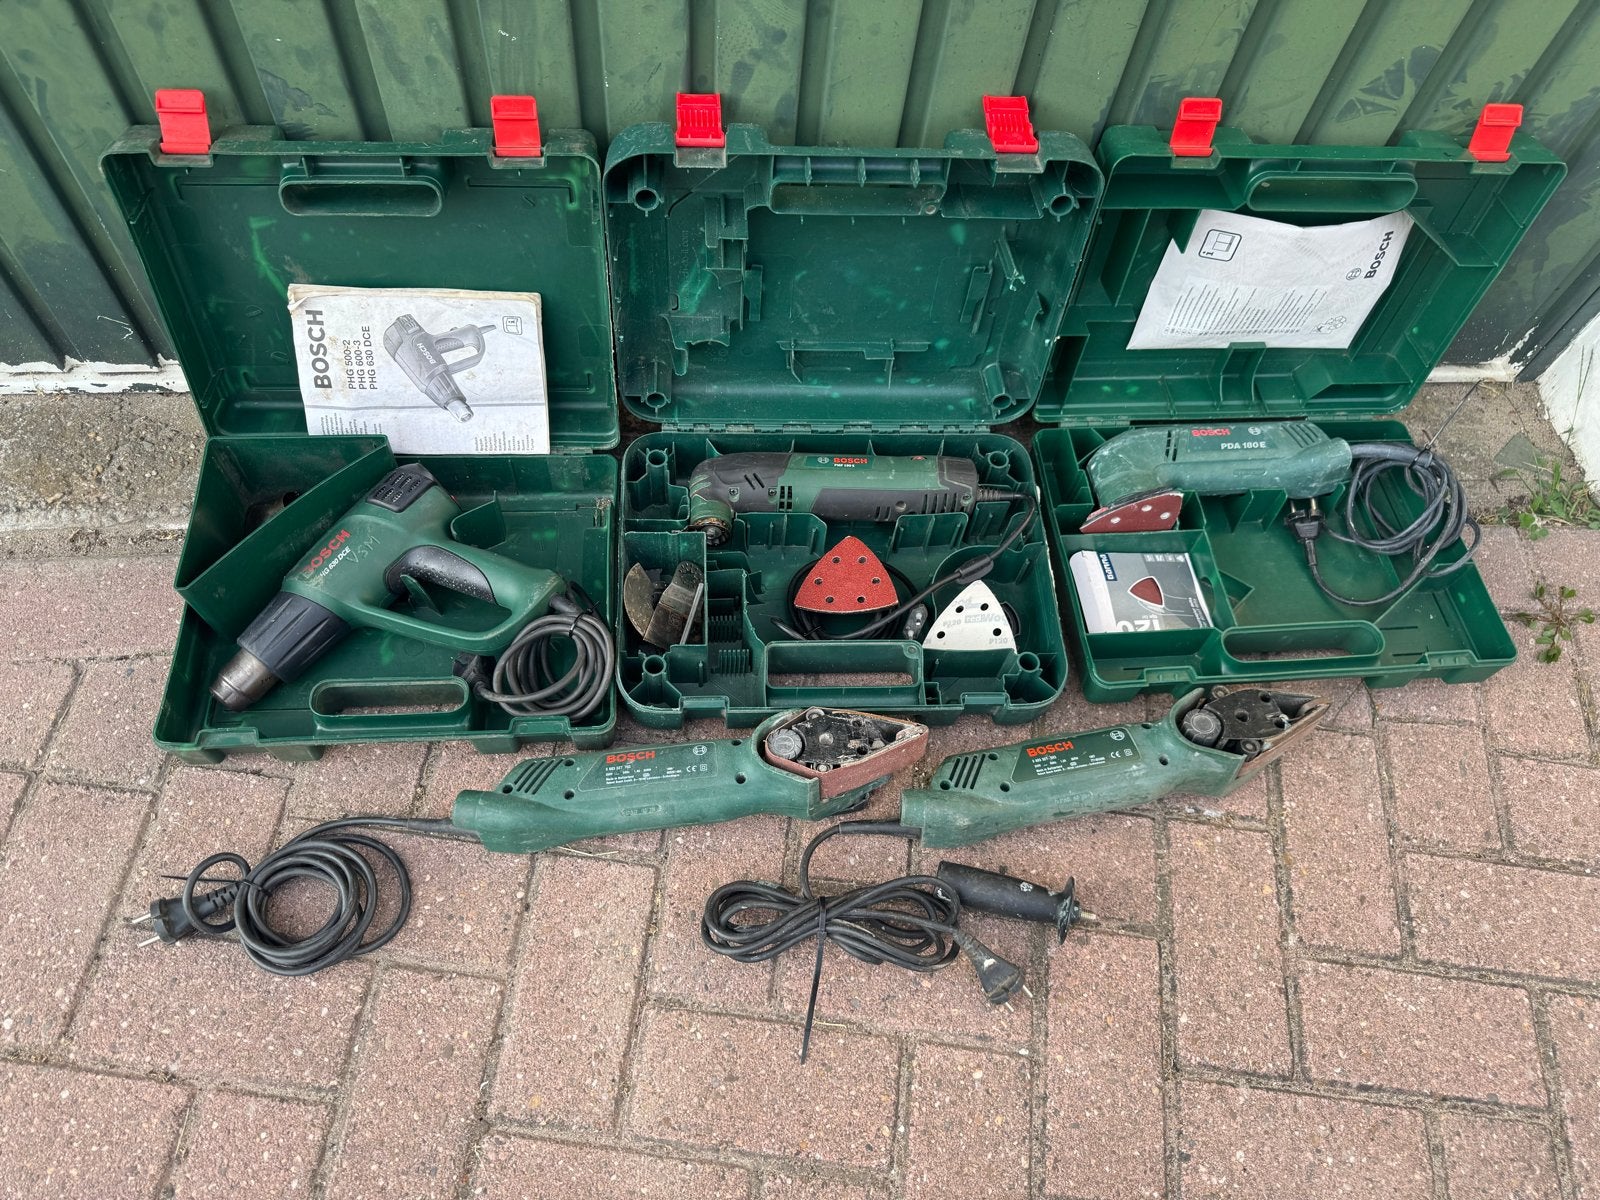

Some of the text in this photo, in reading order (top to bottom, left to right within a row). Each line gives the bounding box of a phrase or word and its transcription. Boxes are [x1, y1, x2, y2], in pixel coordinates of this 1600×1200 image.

[1364, 231, 1394, 279] BOSCH
[305, 309, 333, 389] BOSCH
[362, 325, 378, 389] PHG 630 DCE
[416, 342, 437, 365] BOSCH
[342, 339, 357, 389] PHG 500-2
[353, 339, 367, 389] PHG 600-3
[1191, 428, 1231, 437] BOSCH
[1220, 441, 1241, 450] PDA
[1259, 440, 1267, 448] E
[833, 456, 868, 464] BOSCH
[337, 545, 351, 561] DCE
[606, 751, 656, 764] BOSCH
[1026, 741, 1074, 757] BOSCH
